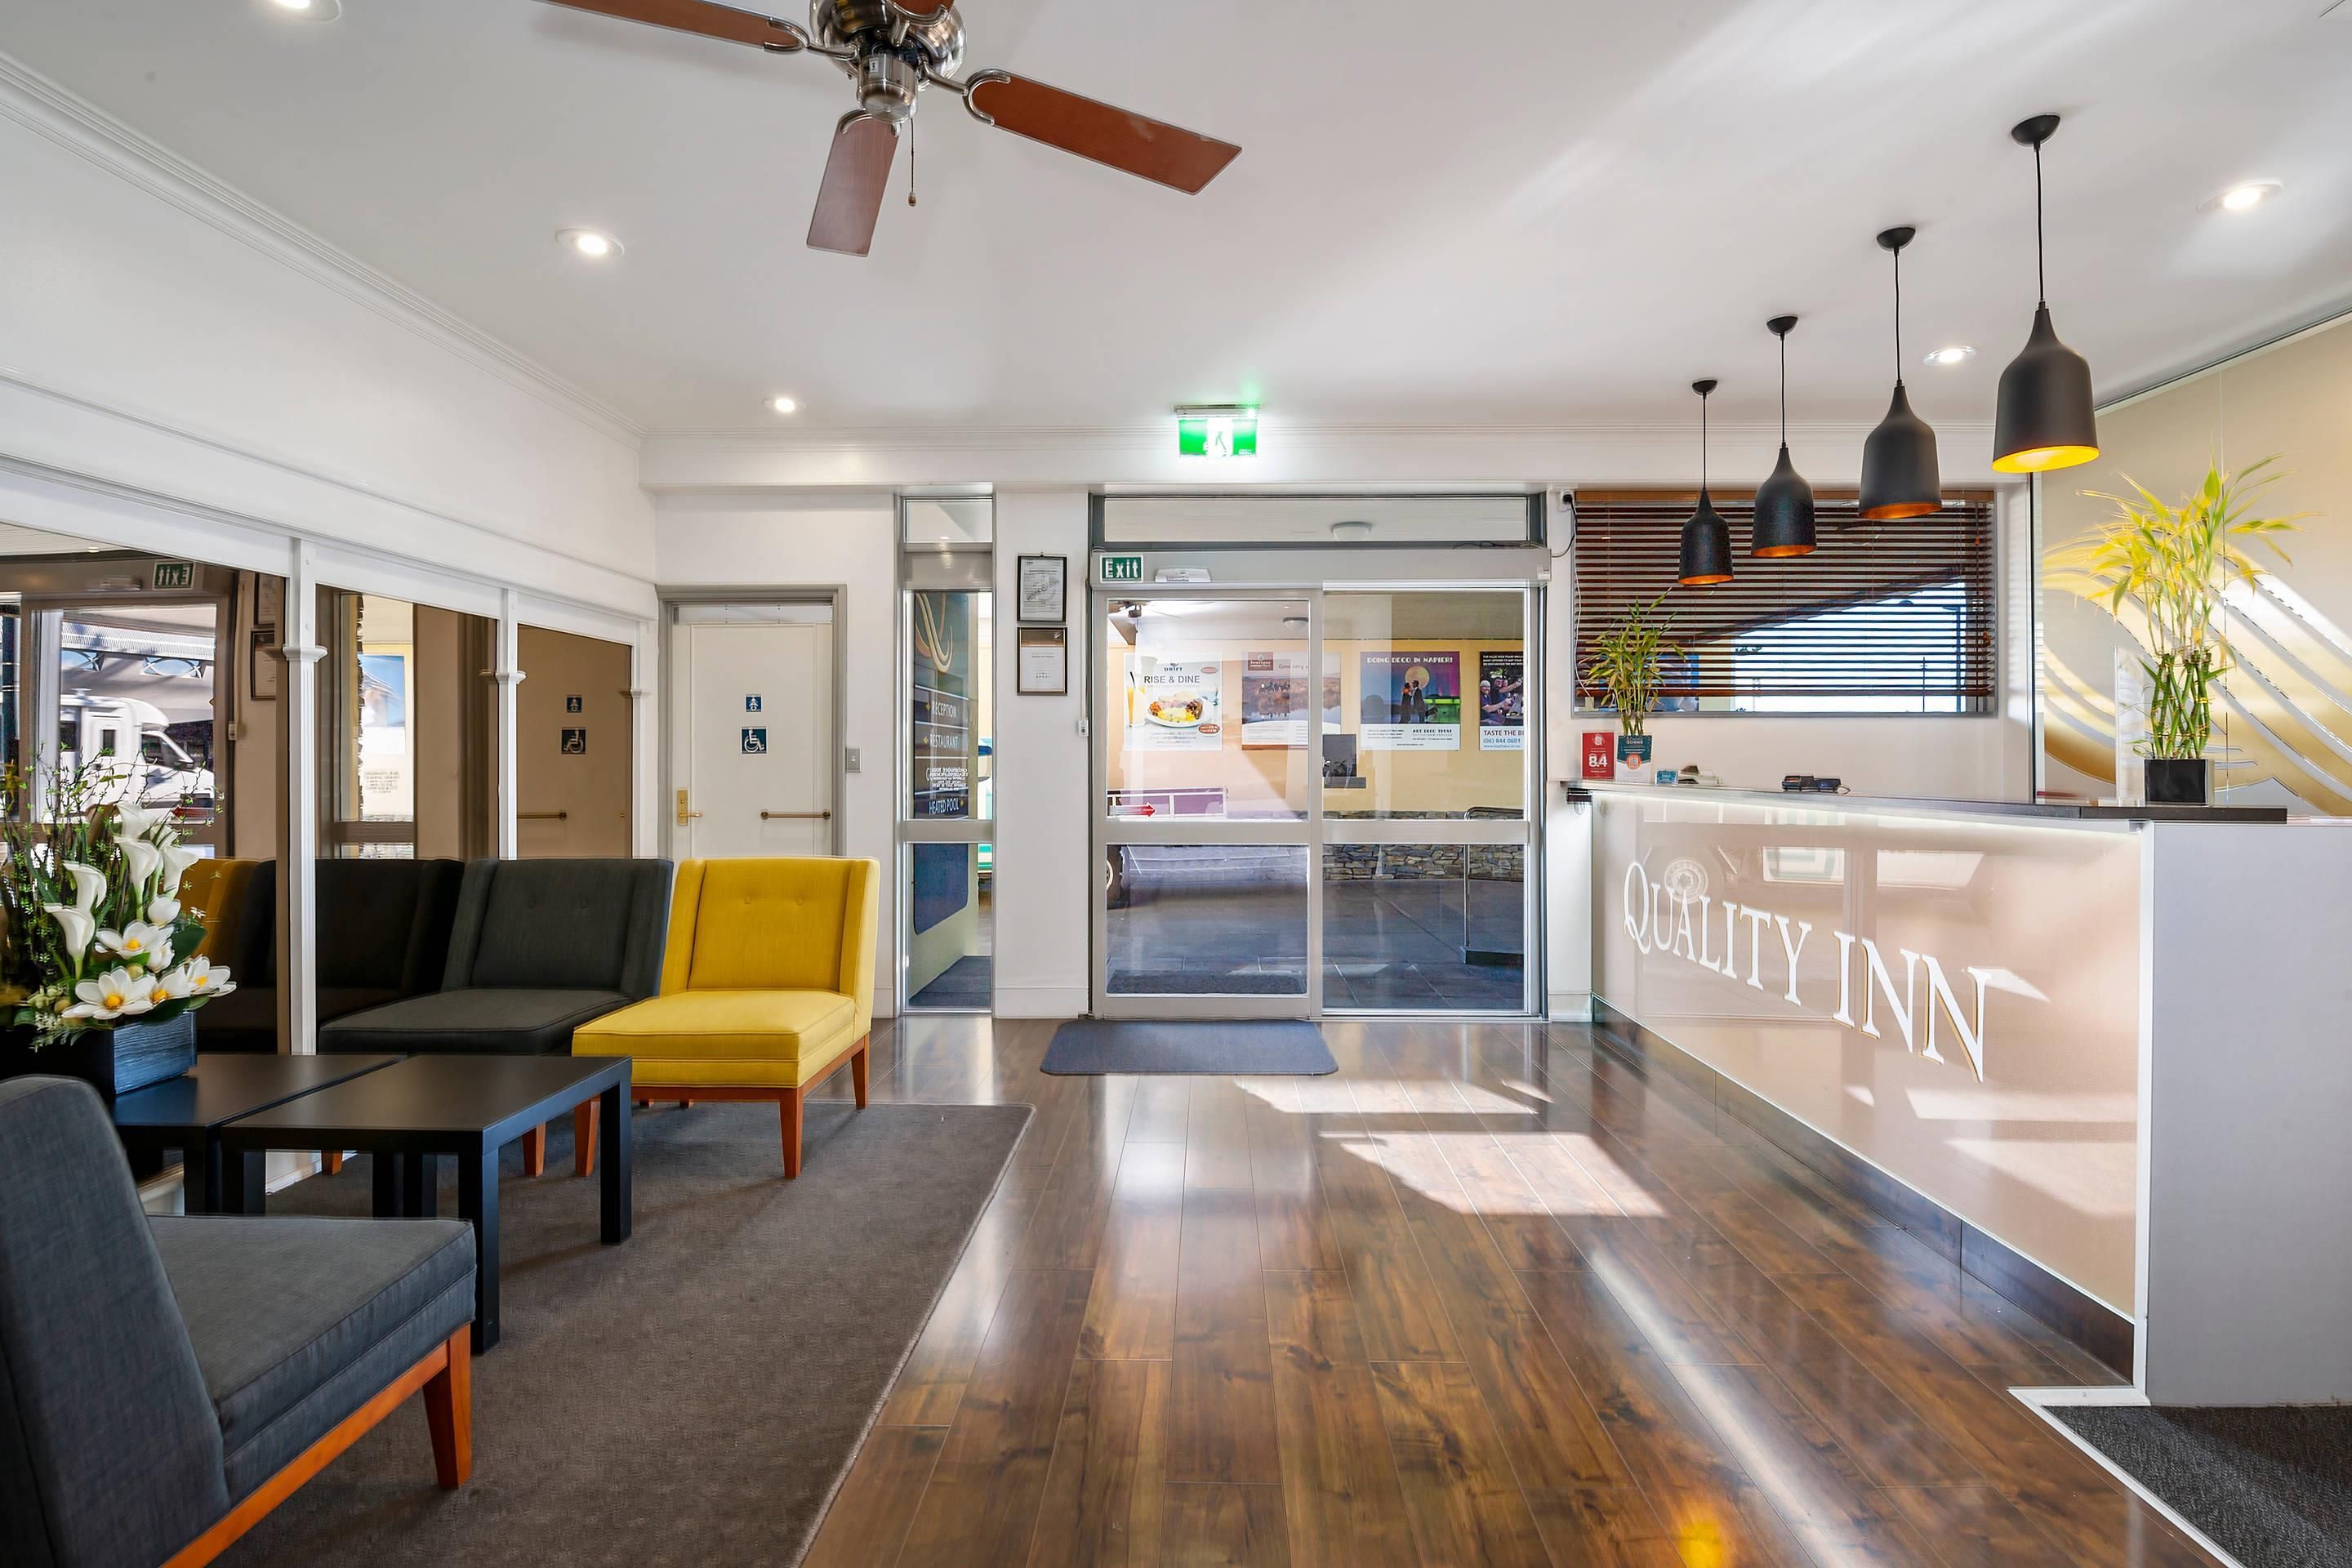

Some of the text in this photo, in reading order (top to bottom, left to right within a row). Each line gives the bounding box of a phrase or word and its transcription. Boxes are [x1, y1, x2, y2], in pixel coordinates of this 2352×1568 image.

[1105, 559, 1138, 578] Exit
[1144, 675, 1200, 684] RISE & DINE
[932, 701, 957, 719] RECEPTION
[929, 733, 959, 749] RESTAURANT
[1588, 753, 1608, 767] 8.4
[929, 798, 960, 815] HEATED POOL
[1623, 862, 1991, 1083] QUALITY INN
